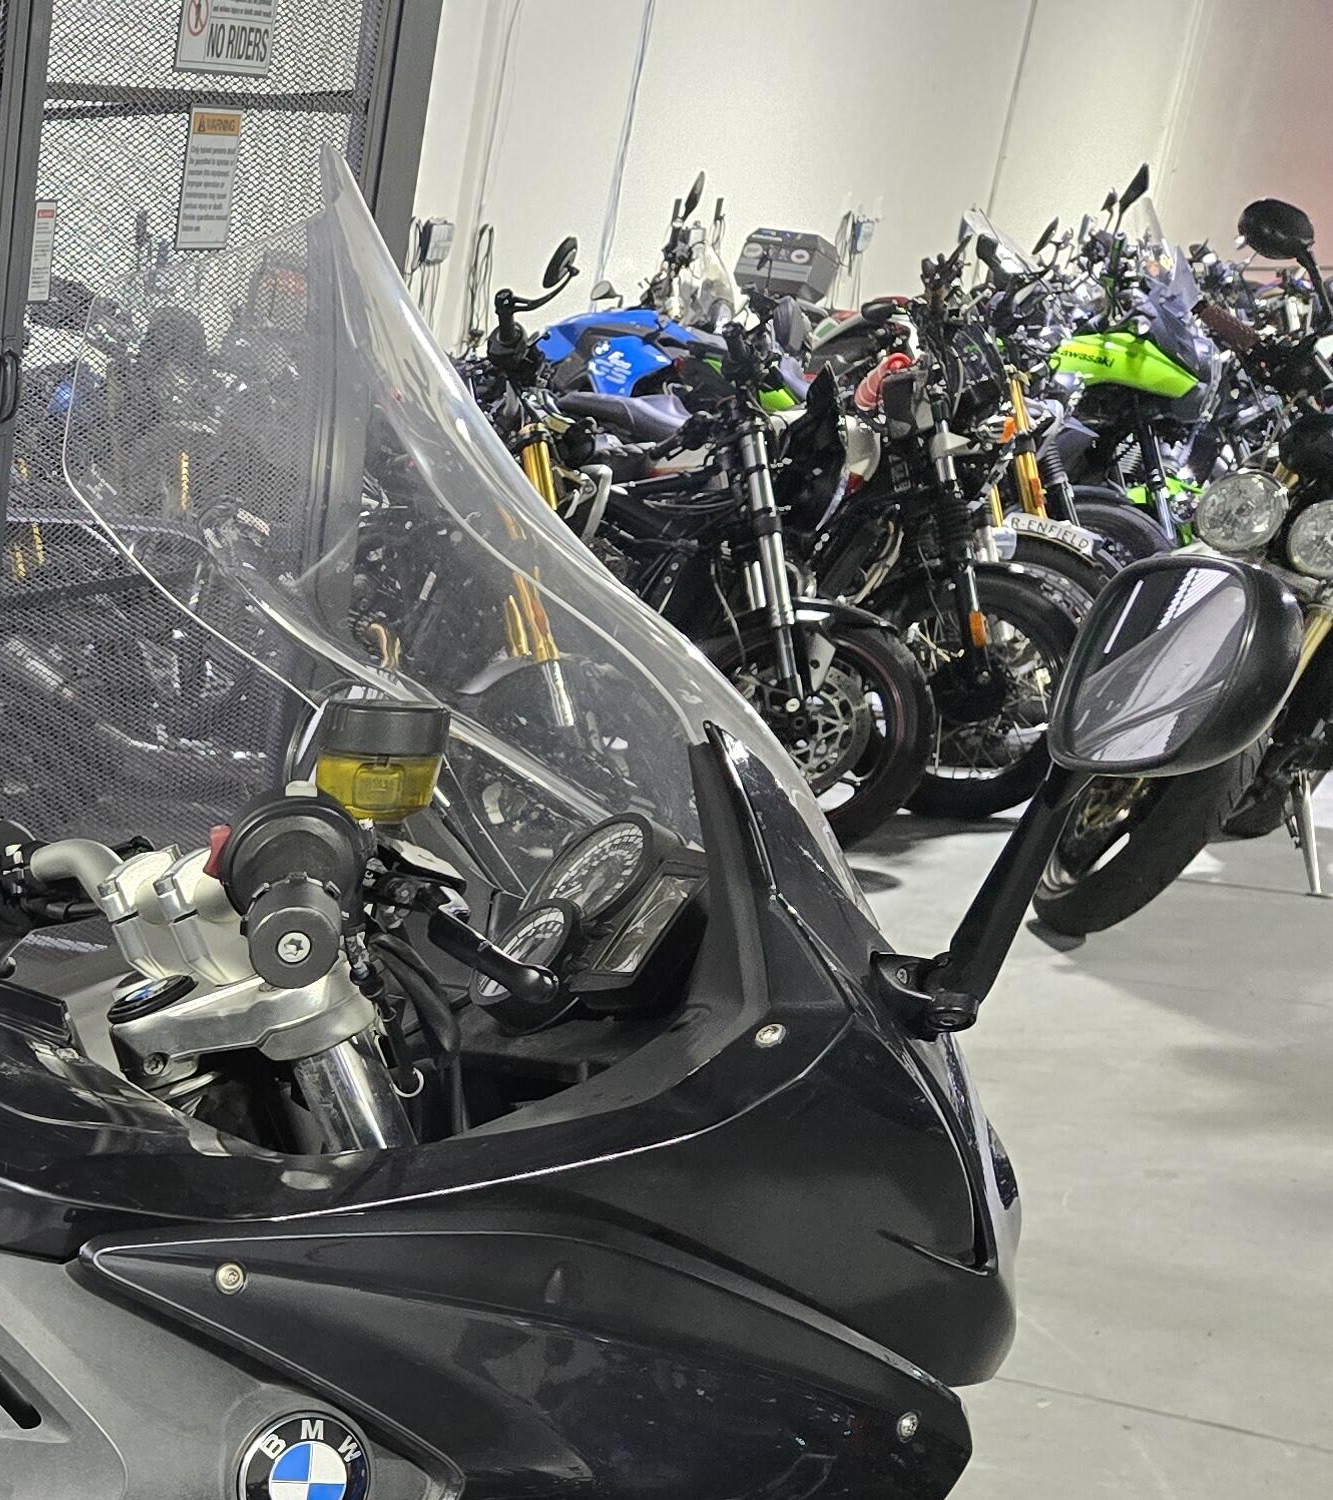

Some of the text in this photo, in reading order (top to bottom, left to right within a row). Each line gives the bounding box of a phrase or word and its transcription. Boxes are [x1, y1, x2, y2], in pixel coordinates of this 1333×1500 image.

[206, 23, 270, 62] NO RIDERS
[1010, 517, 1090, 548] R-ENFIELD
[259, 1419, 362, 1463] BMW
